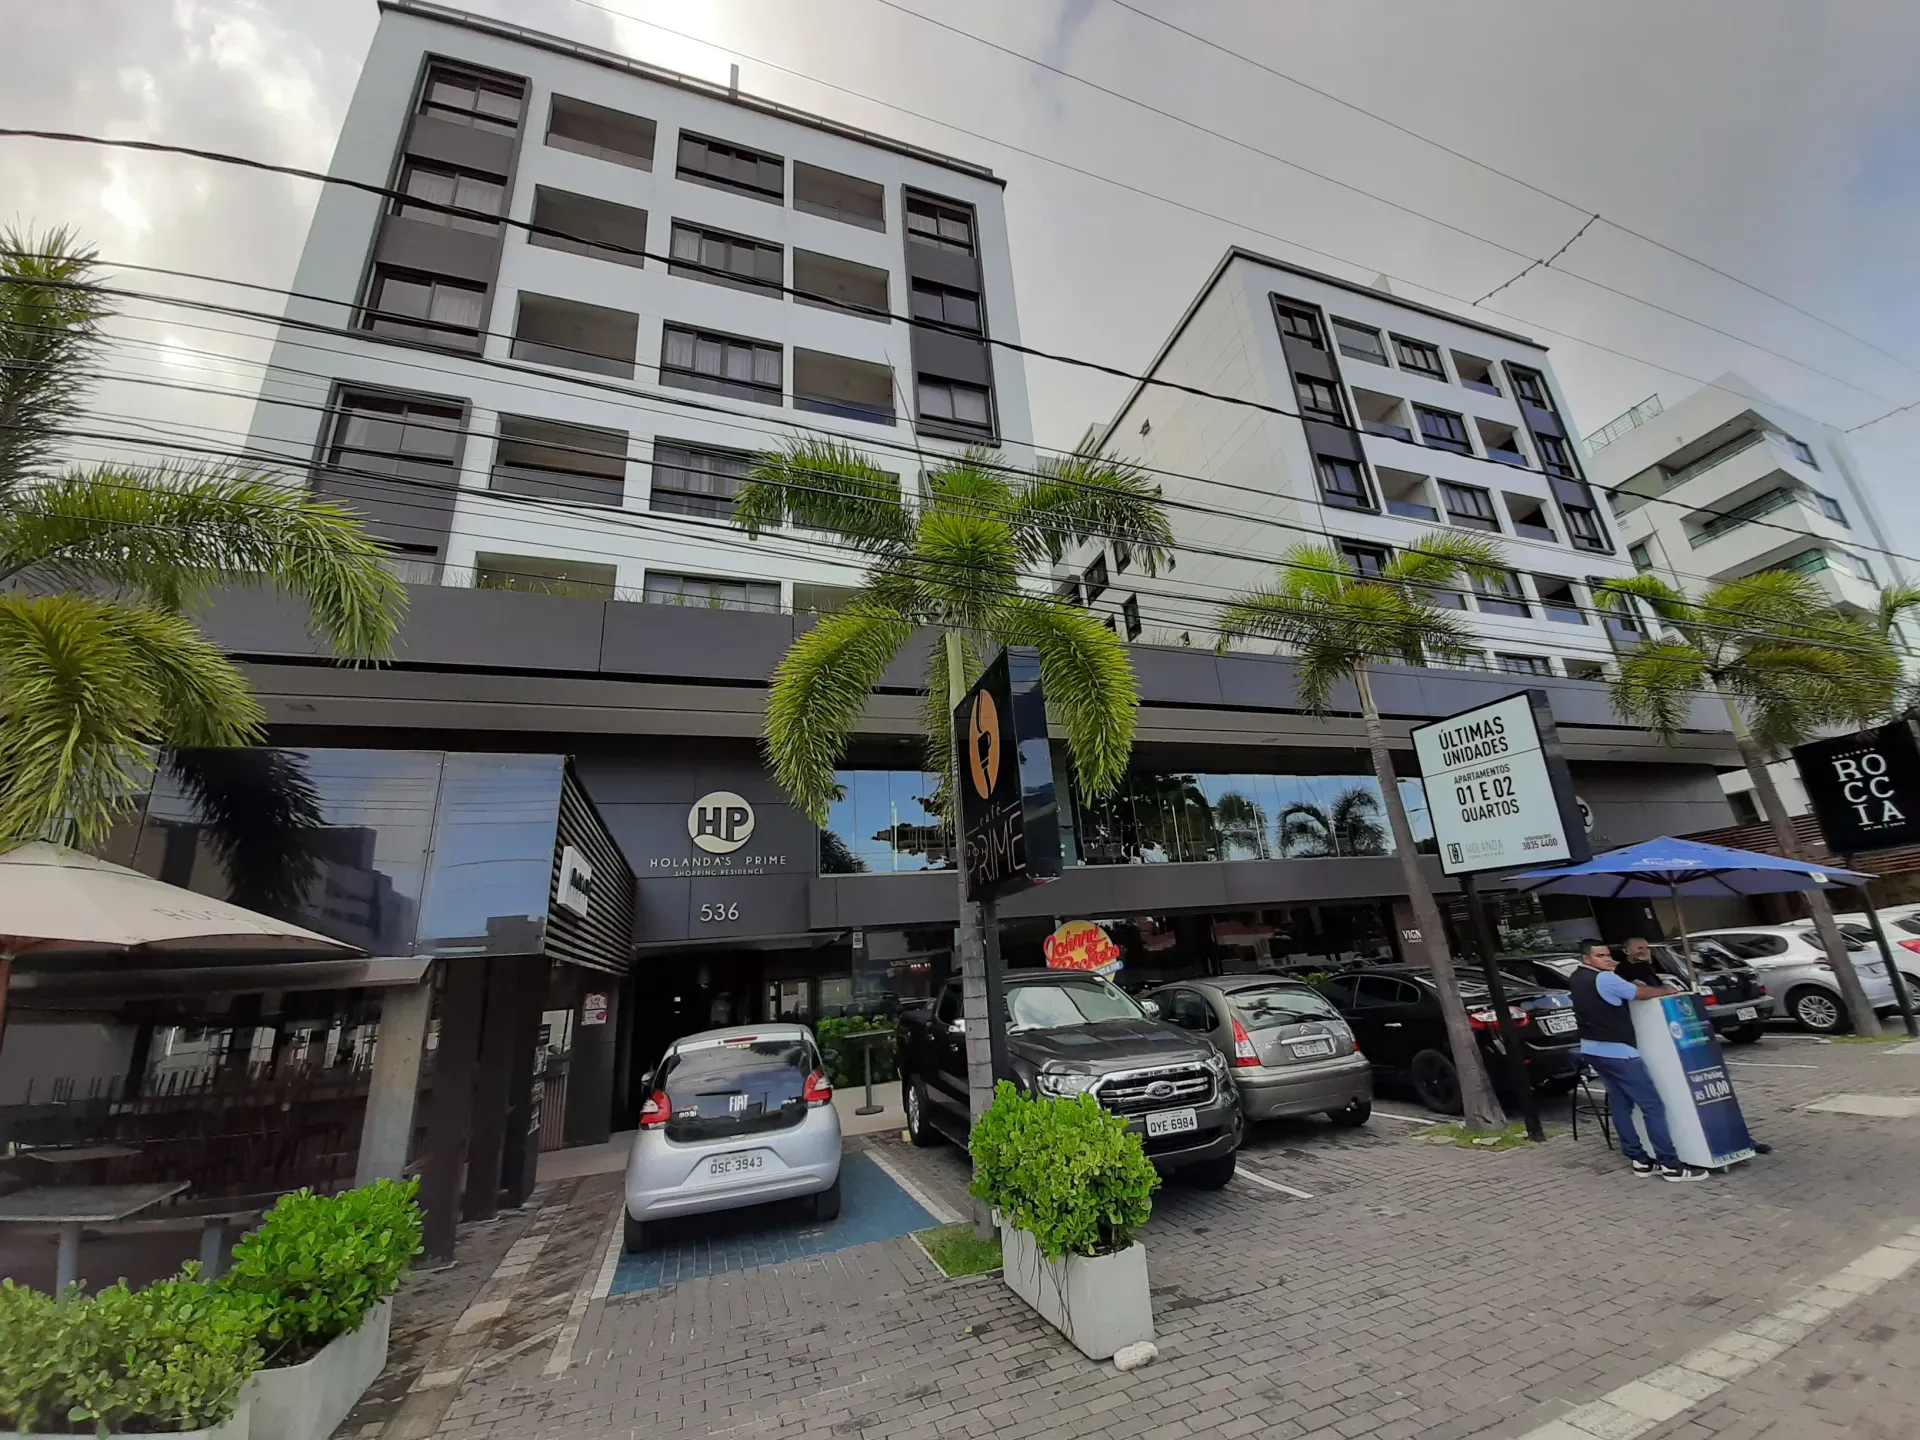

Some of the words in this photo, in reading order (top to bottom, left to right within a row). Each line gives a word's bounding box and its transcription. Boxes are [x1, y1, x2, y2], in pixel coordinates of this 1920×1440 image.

[1439, 716, 1505, 750] ÚLTIMAS
[1443, 736, 1509, 767] UNIDADES
[1453, 764, 1511, 785] APARTAMENTOS
[1456, 785, 1475, 806] 01
[1479, 781, 1491, 801] E
[1493, 776, 1516, 799] 02
[979, 801, 1001, 827] café
[1461, 799, 1520, 823] QUARTOS
[697, 806, 750, 842] HP
[966, 811, 1027, 891] PRIME
[1522, 840, 1539, 851] 3035
[1540, 838, 1558, 848] 4400
[674, 869, 717, 877] SHOPPING
[720, 868, 764, 876] RESIDENCE
[745, 855, 787, 866] PRIME
[700, 902, 739, 922] 536
[1043, 923, 1107, 964] Johnny
[1048, 940, 1121, 970] Rockets
[1704, 1080, 1730, 1099] 10,00
[729, 1094, 750, 1112] FIAT
